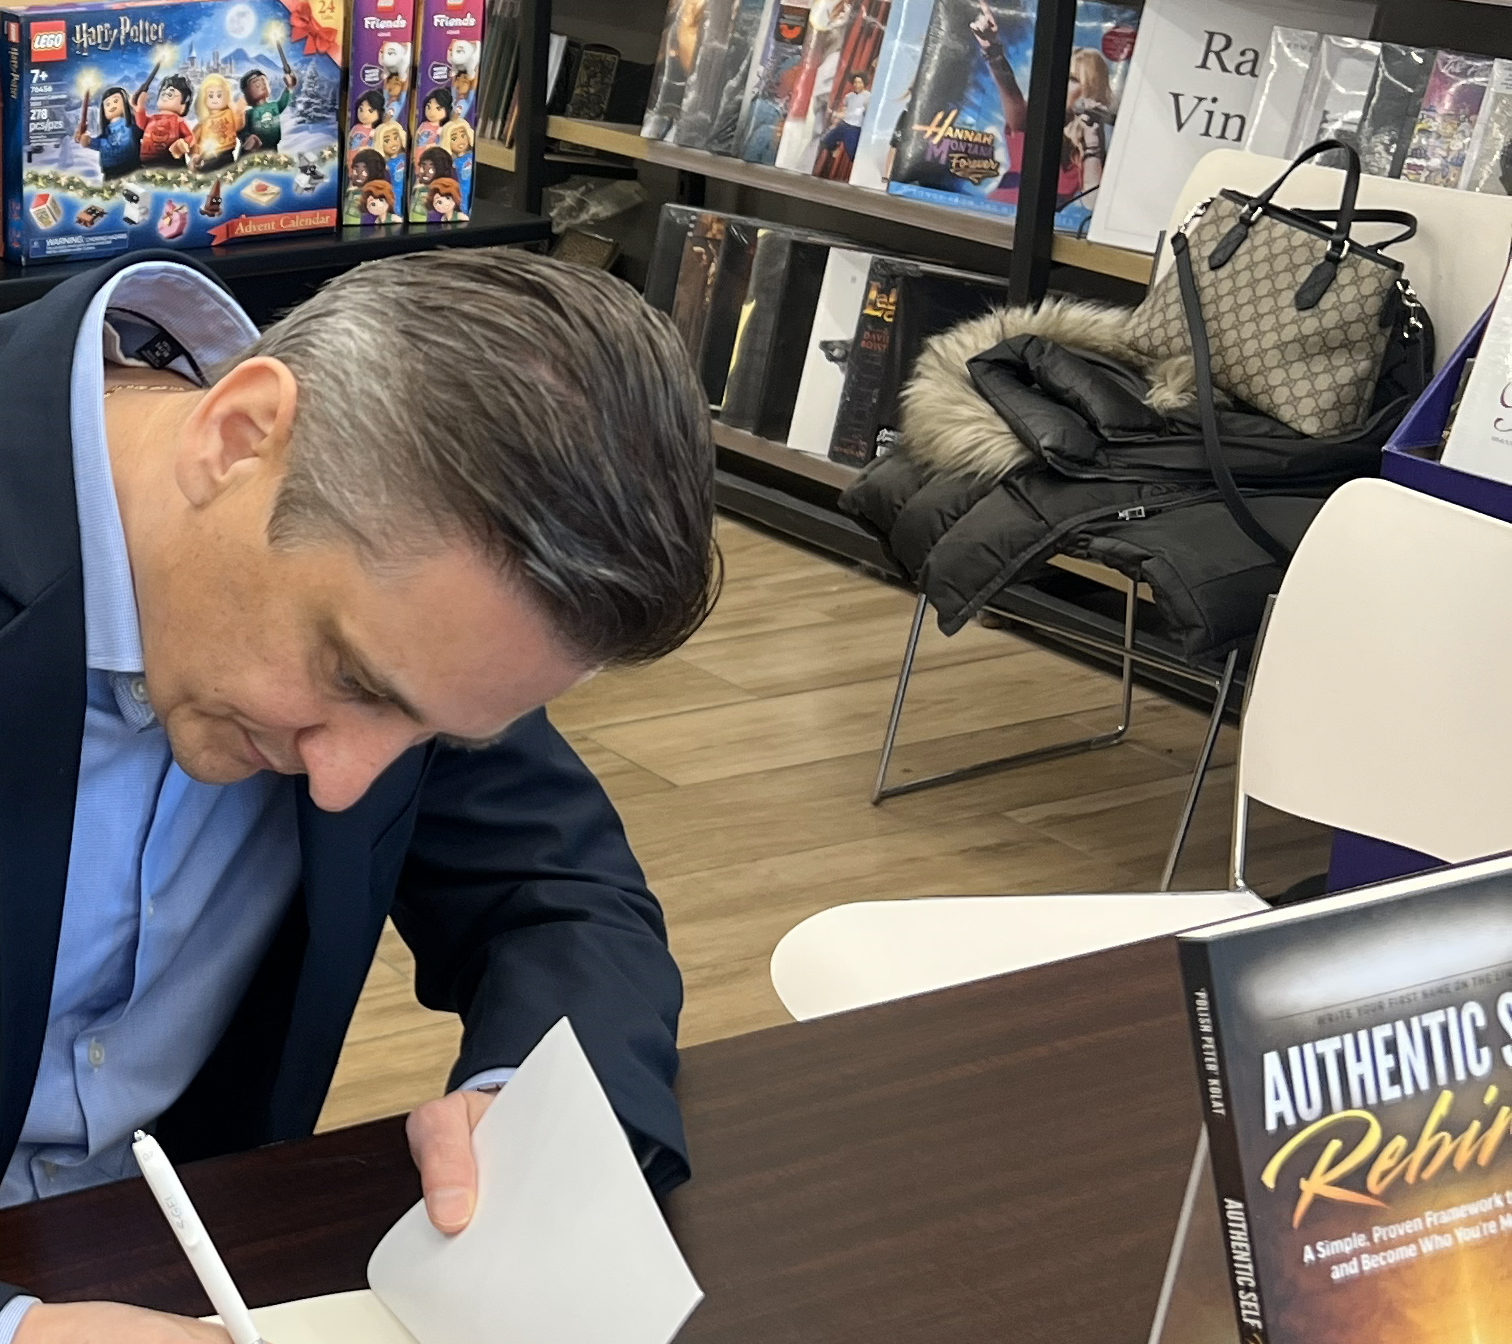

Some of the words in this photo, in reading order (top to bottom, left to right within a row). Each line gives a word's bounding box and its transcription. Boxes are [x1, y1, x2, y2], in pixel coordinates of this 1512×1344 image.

[317, 0, 336, 16] 24
[432, 11, 476, 28] Friends
[33, 32, 64, 52] LEGO
[72, 21, 120, 52] Harry
[119, 15, 165, 45] Potter
[363, 14, 407, 30] Friends
[1195, 29, 1261, 78] Ra
[29, 69, 49, 84] 7+
[30, 109, 48, 121] 278
[30, 120, 64, 131] pcs/pzs
[913, 107, 995, 146] HANNAH
[1169, 91, 1249, 143] Vin
[949, 154, 1000, 176] Forever
[234, 216, 276, 236] Advent
[279, 213, 331, 230] Calendar
[1263, 1000, 1493, 1133] AUTHENTIC
[1372, 1218, 1423, 1243] Proven
[1425, 1197, 1505, 1229] Framework
[1360, 1240, 1419, 1274] Become
